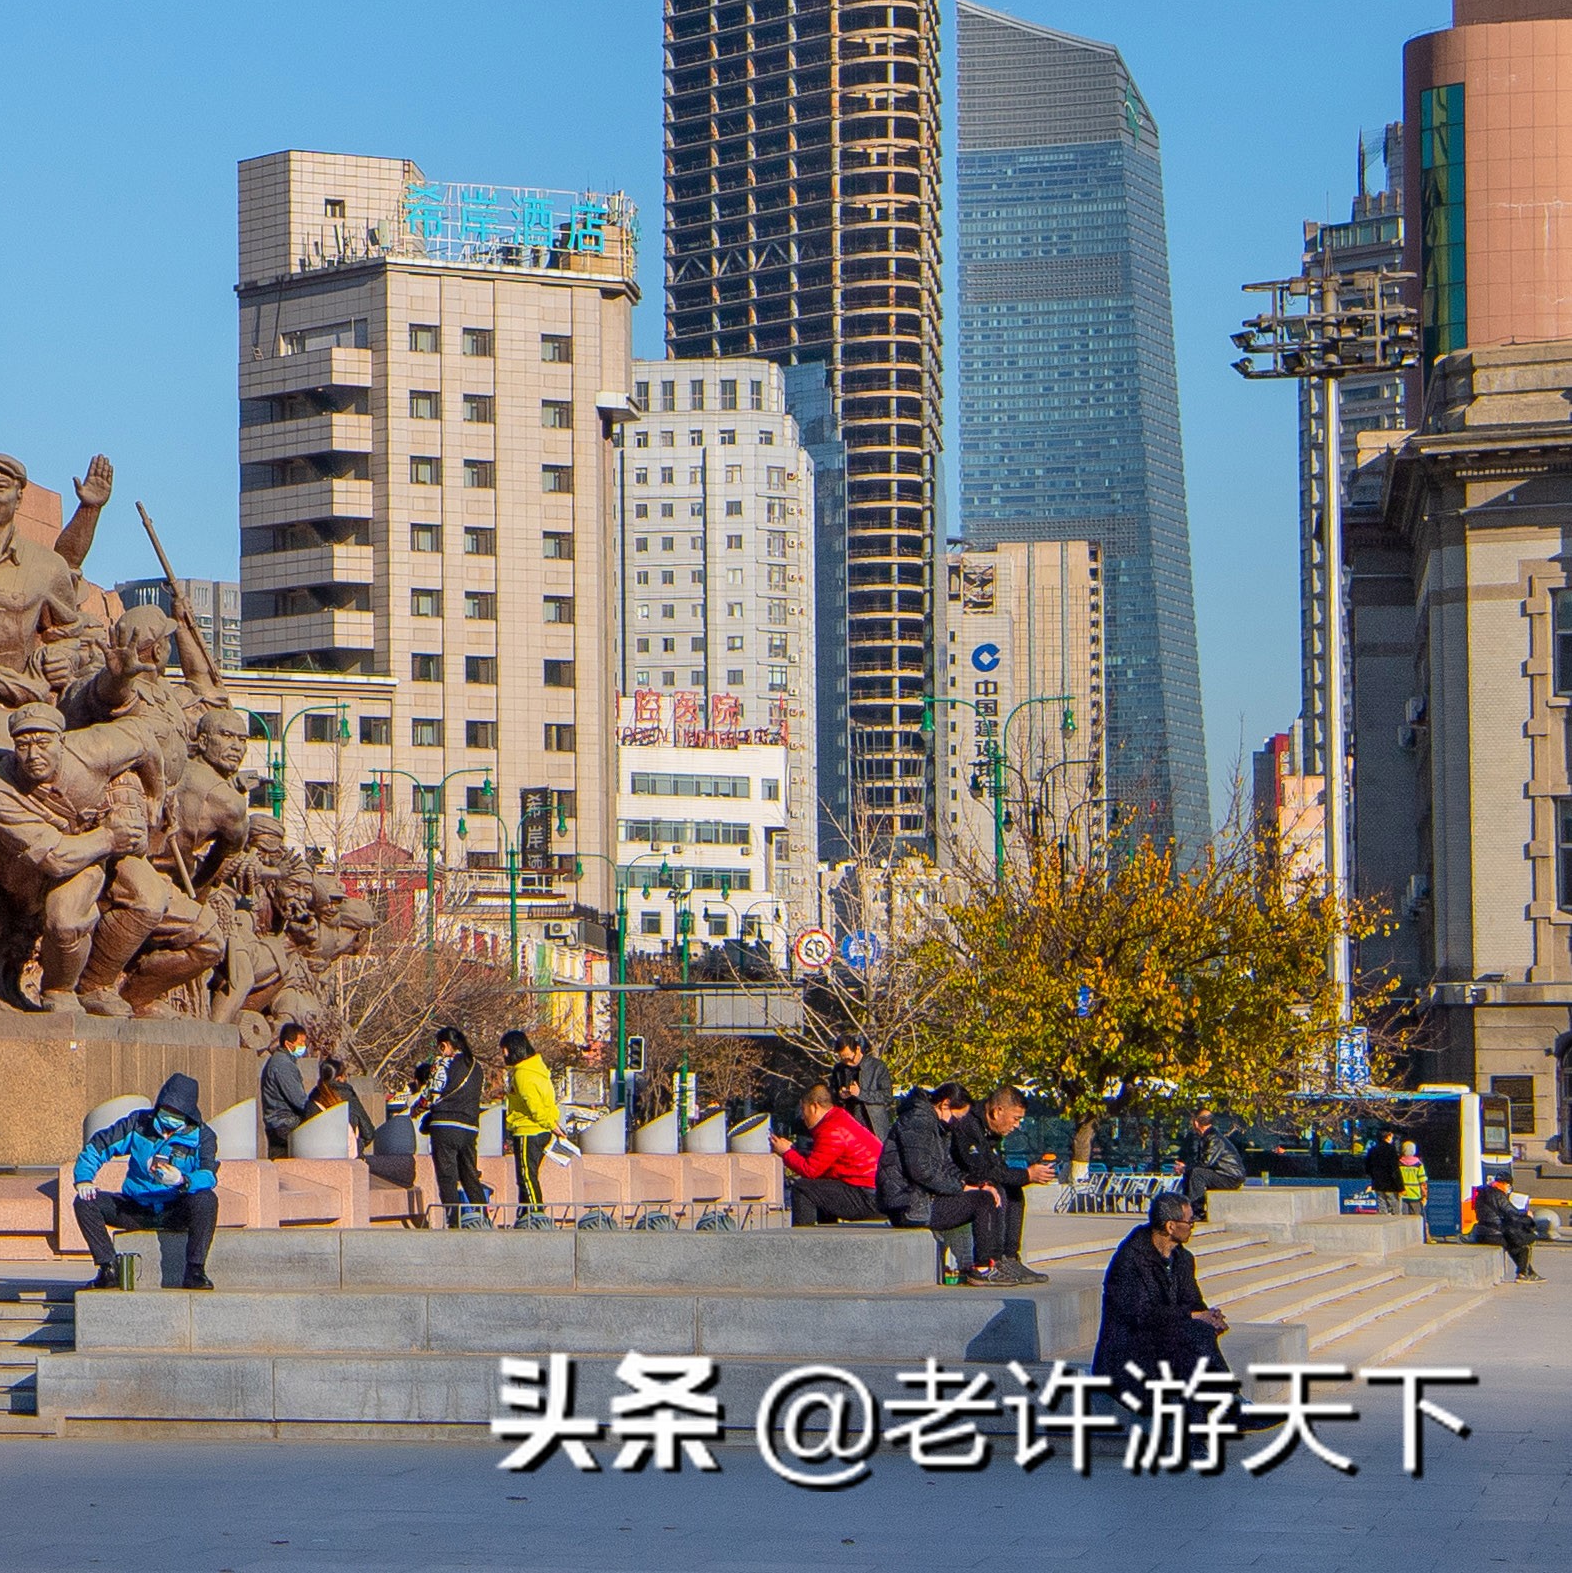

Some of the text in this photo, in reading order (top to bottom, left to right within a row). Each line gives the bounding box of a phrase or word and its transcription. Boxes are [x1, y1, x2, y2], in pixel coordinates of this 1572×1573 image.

[402, 184, 609, 253] 希岸酒店
[615, 688, 740, 727] 腔医院
[974, 679, 999, 798] 中国建设
